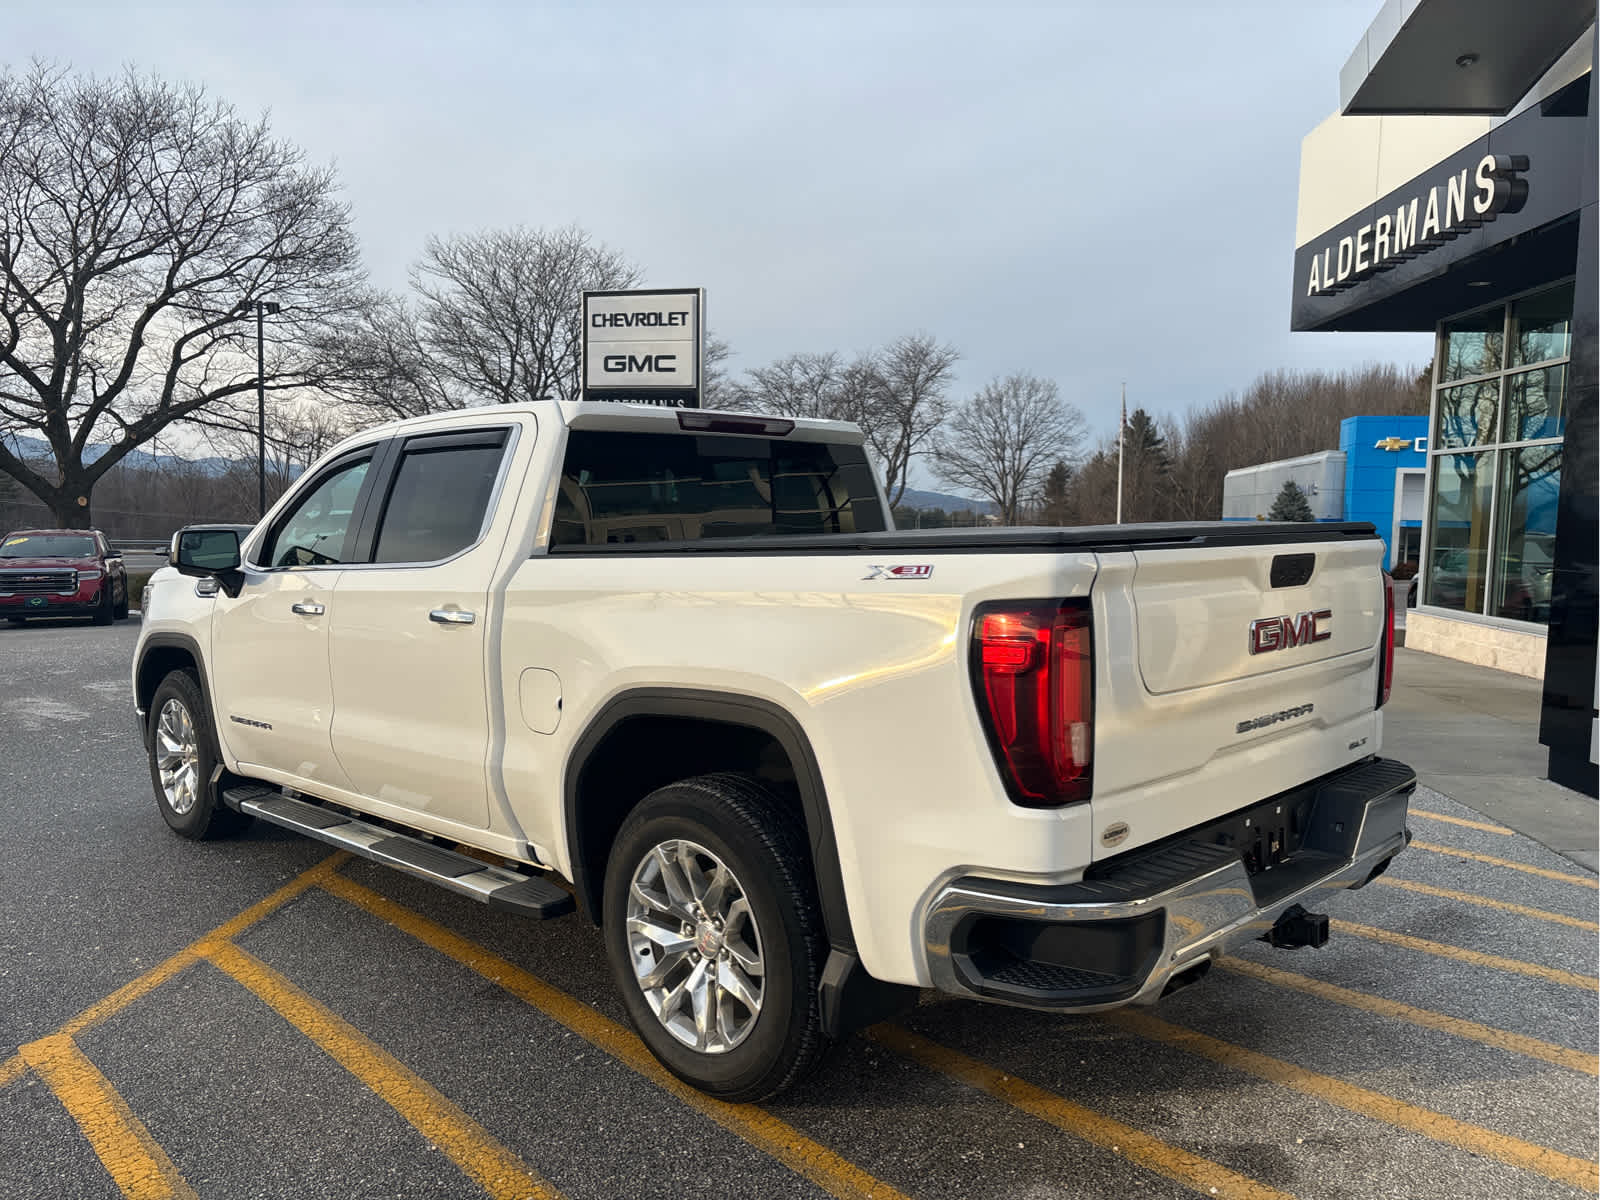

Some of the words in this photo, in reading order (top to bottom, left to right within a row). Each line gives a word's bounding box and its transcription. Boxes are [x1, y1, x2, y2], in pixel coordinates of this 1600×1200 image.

[1307, 154, 1497, 297] ALDERMANS
[592, 311, 689, 327] CHEVROLET
[604, 355, 677, 372] GMC
[1249, 609, 1332, 656] GMC
[1236, 703, 1314, 734] SIERRA
